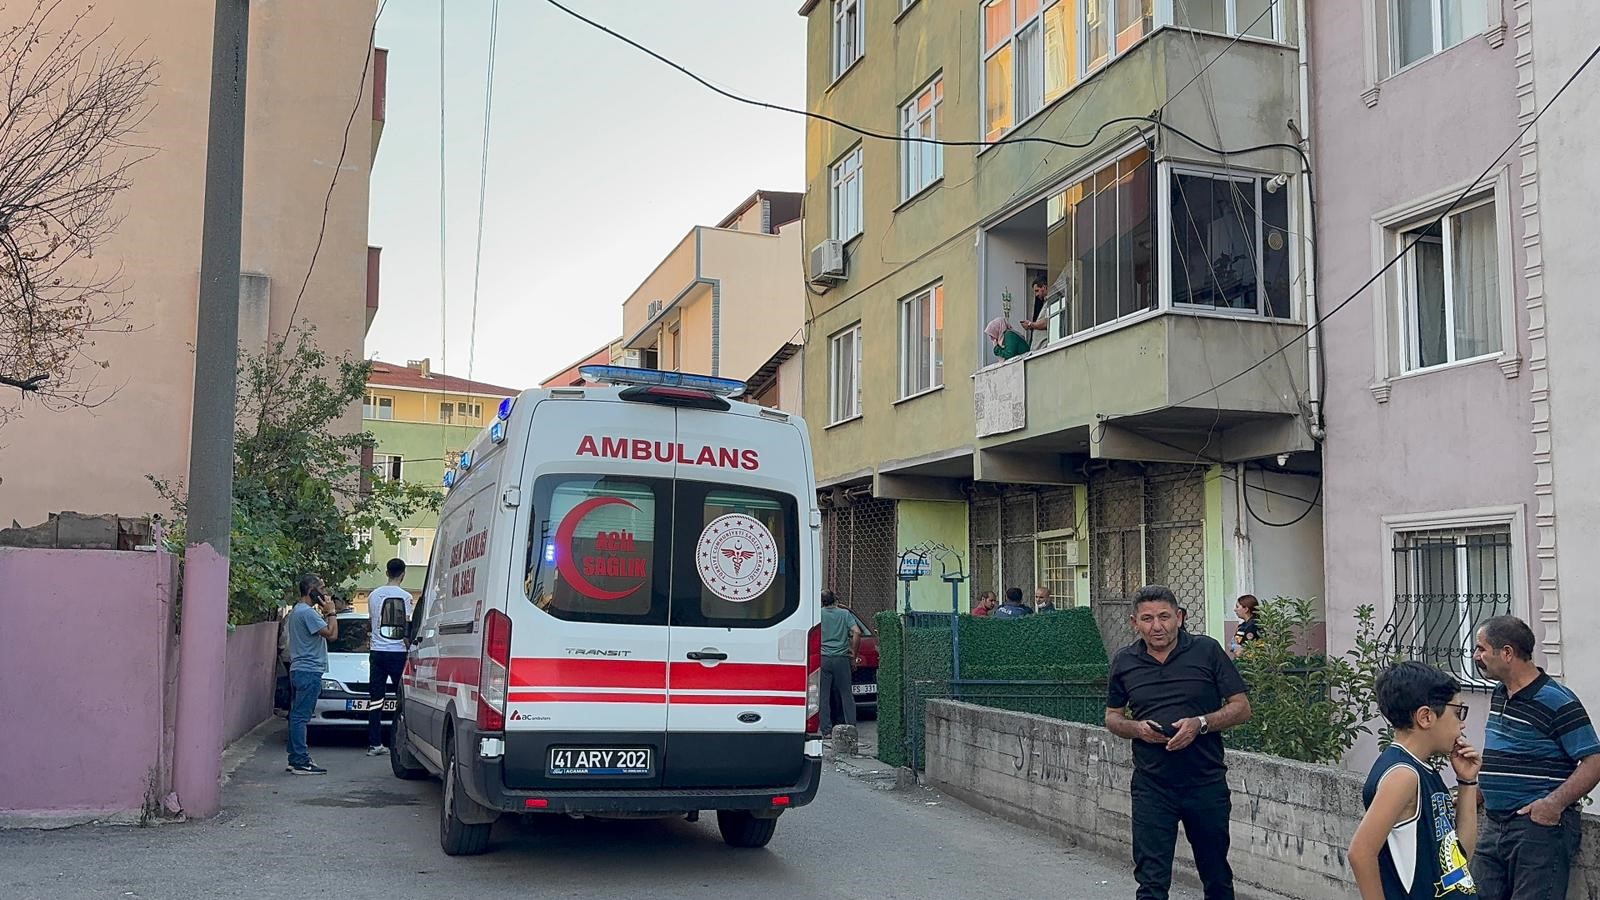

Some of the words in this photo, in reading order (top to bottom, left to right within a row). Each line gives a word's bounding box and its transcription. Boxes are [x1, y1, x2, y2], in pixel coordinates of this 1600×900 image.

[576, 435, 760, 471] AMBULANS
[595, 528, 636, 552] ACİL
[583, 552, 647, 577] SAĞLIK
[565, 648, 632, 657] TRANSIT
[352, 701, 363, 710] 46
[555, 751, 572, 768] 41
[575, 751, 614, 768] ARY
[616, 751, 646, 768] 202
